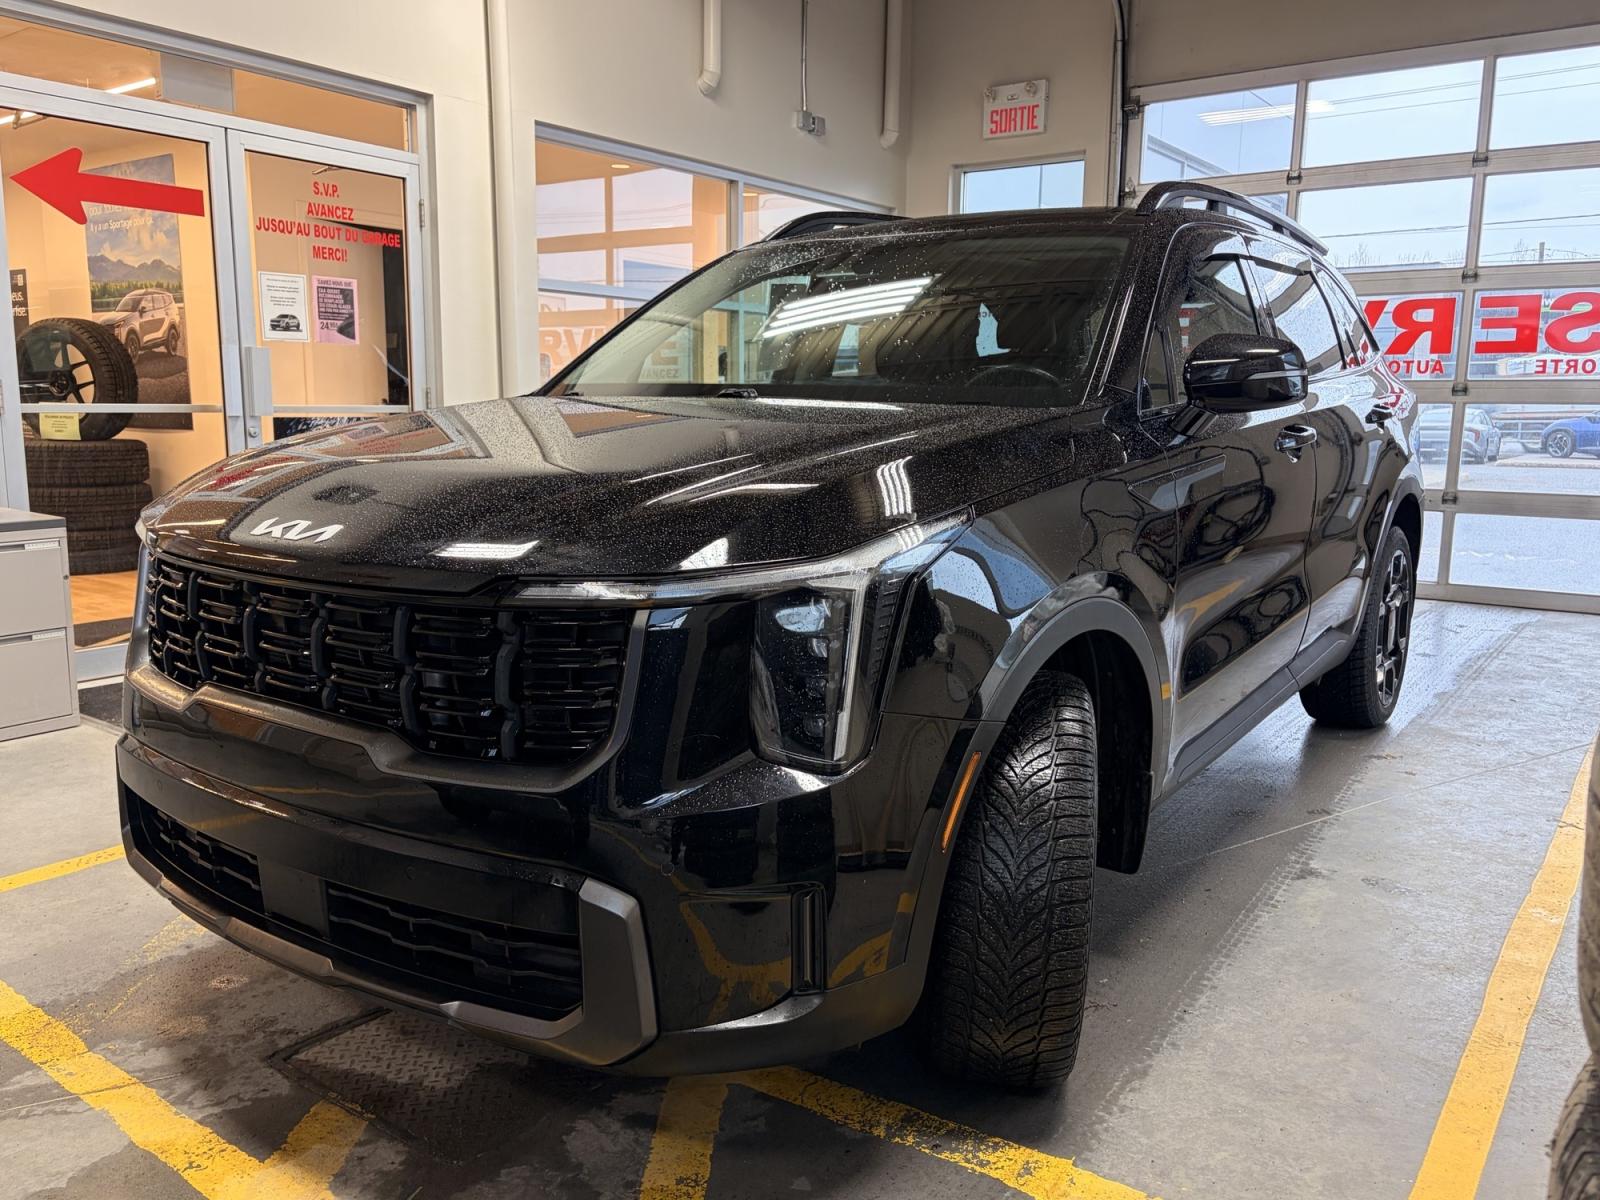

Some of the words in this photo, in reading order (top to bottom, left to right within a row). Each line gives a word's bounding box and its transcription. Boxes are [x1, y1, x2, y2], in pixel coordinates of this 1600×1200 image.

[989, 103, 1040, 135] SORTIE
[312, 181, 340, 198] S.V.P.
[307, 201, 354, 221] AVANCEZ
[109, 218, 132, 232] Sportage
[256, 216, 310, 237] JUSQU'AU
[313, 224, 342, 240] BOUT
[345, 228, 358, 242] DU
[361, 230, 400, 248] GARAGE
[312, 245, 347, 262] MERCI!
[250, 517, 344, 544] KIA
